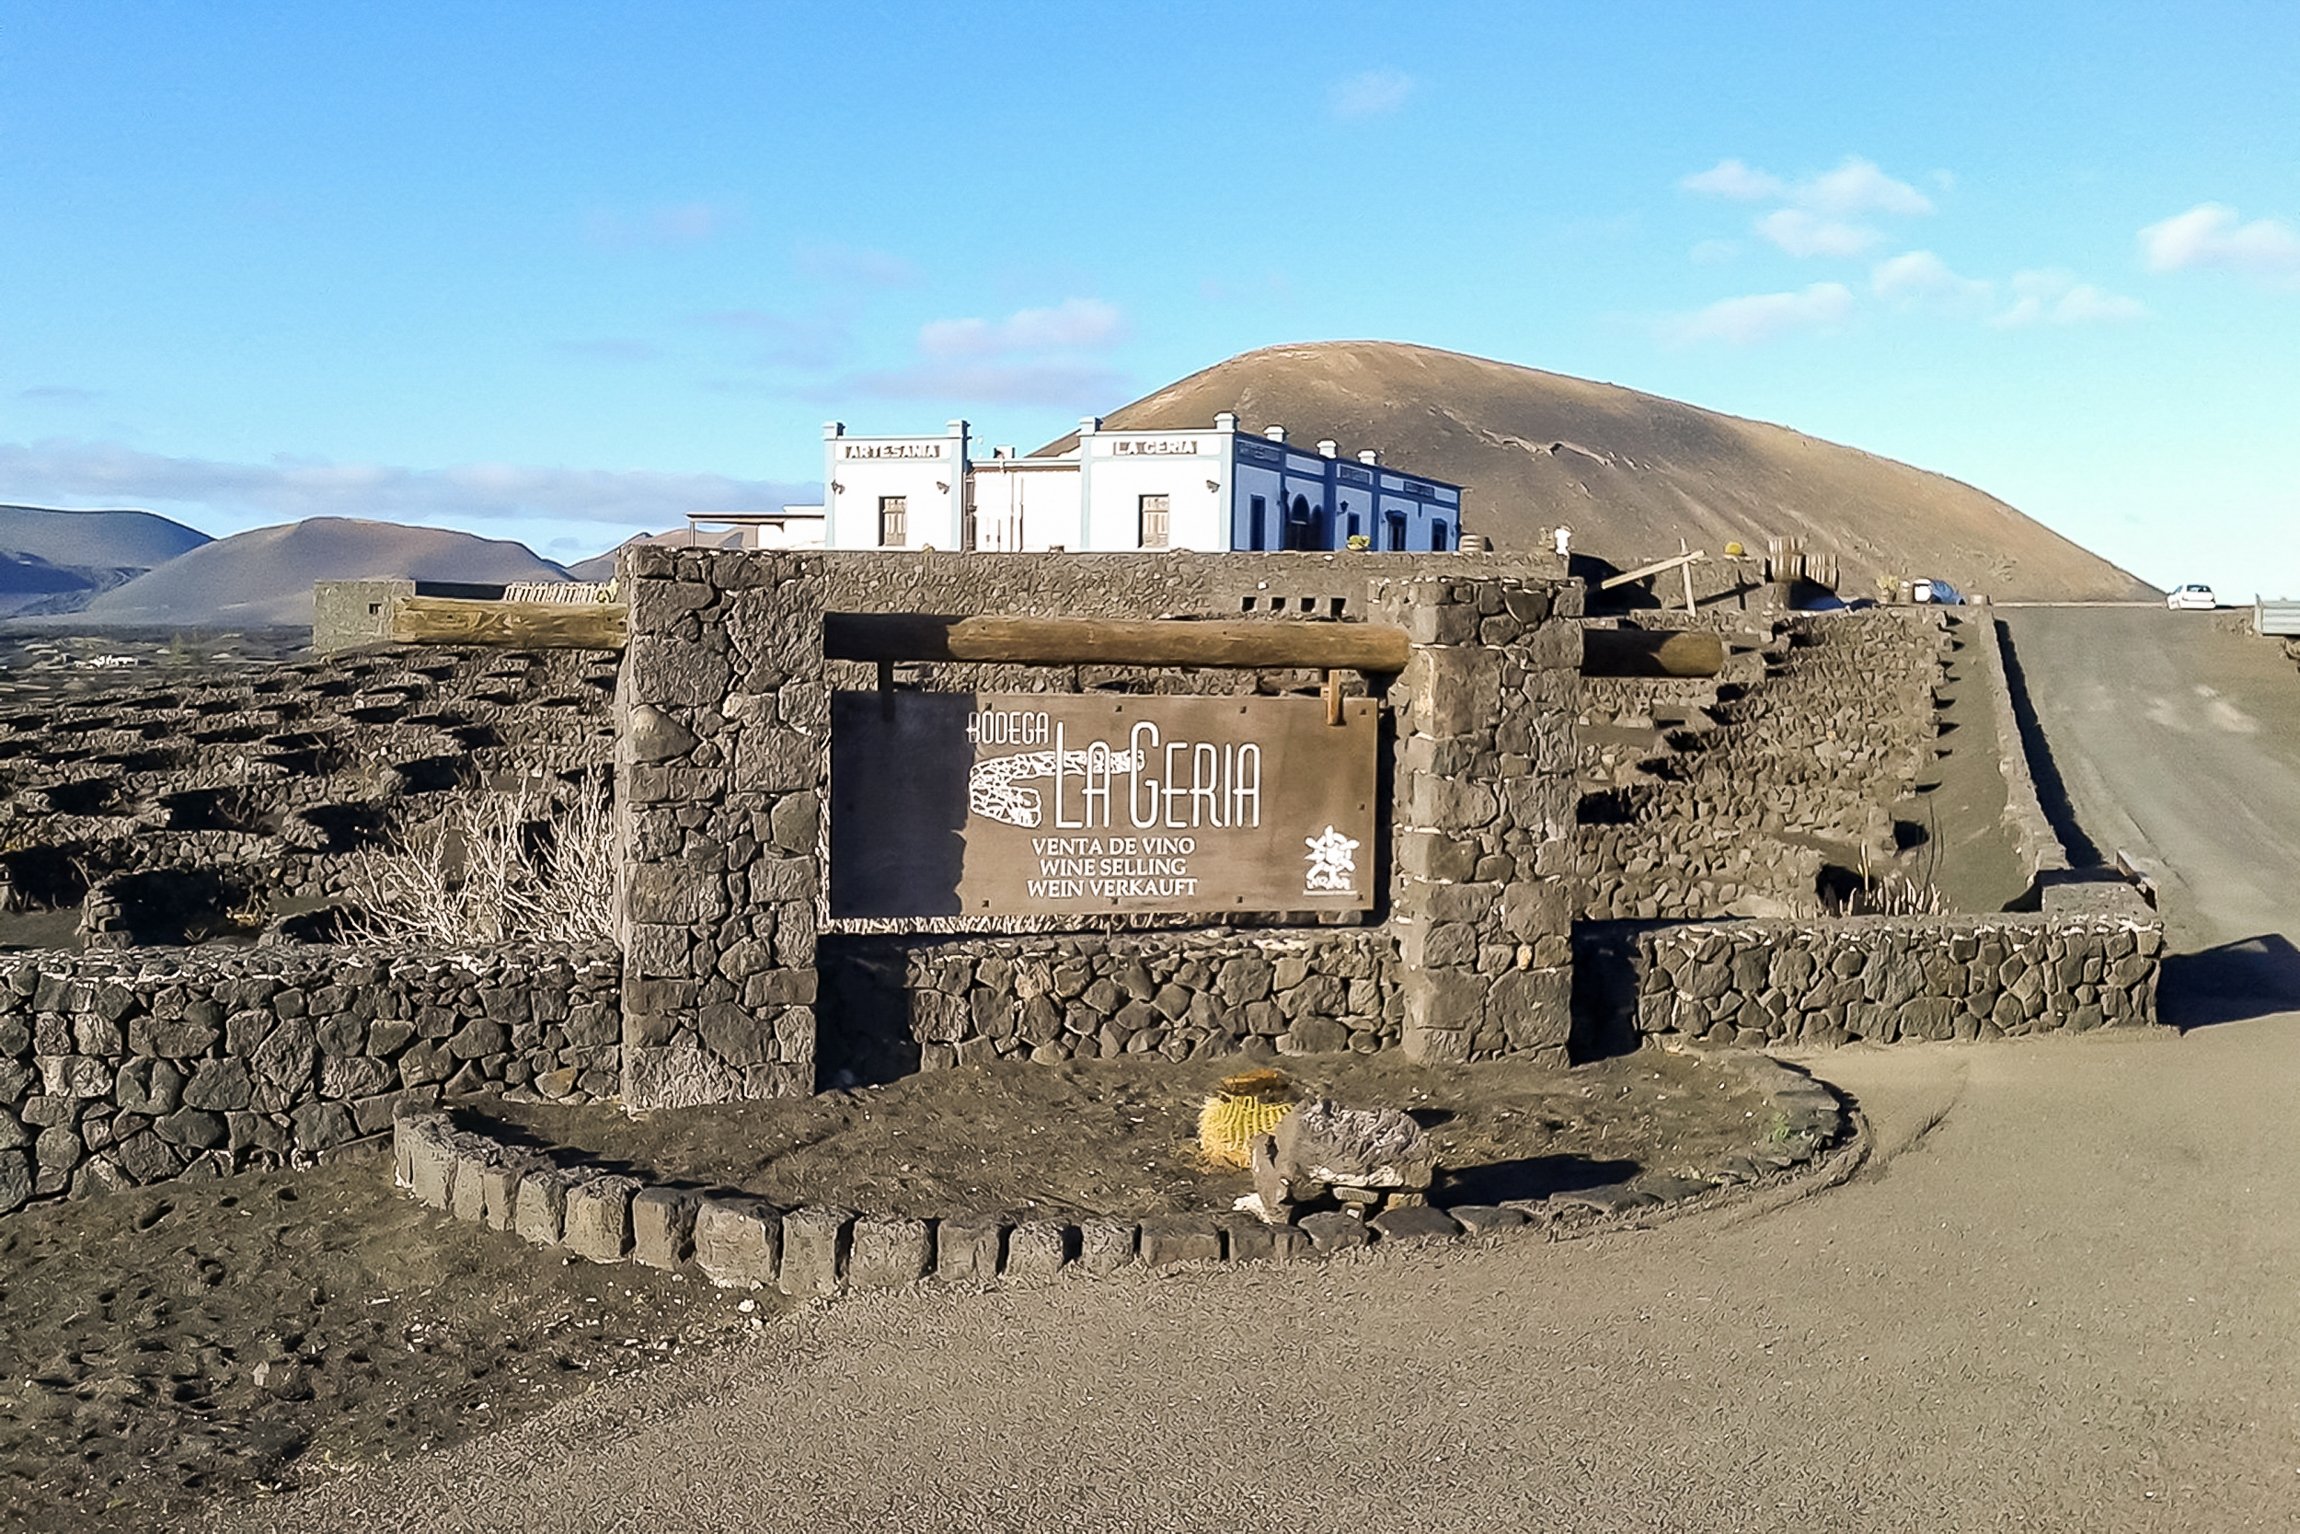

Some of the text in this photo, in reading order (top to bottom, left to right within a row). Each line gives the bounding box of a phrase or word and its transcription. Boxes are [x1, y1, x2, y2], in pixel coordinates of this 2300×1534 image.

[847, 445, 939, 459] ARTESANIA
[1115, 441, 1196, 455] LA GERIA
[966, 710, 1049, 744] BODEGA
[1056, 721, 1260, 829] LA GERIA
[1031, 837, 1196, 856] VENTA DE VINO
[1039, 858, 1187, 877] WINE SELLING
[1027, 878, 1198, 897] WEIN VERKAUFT
